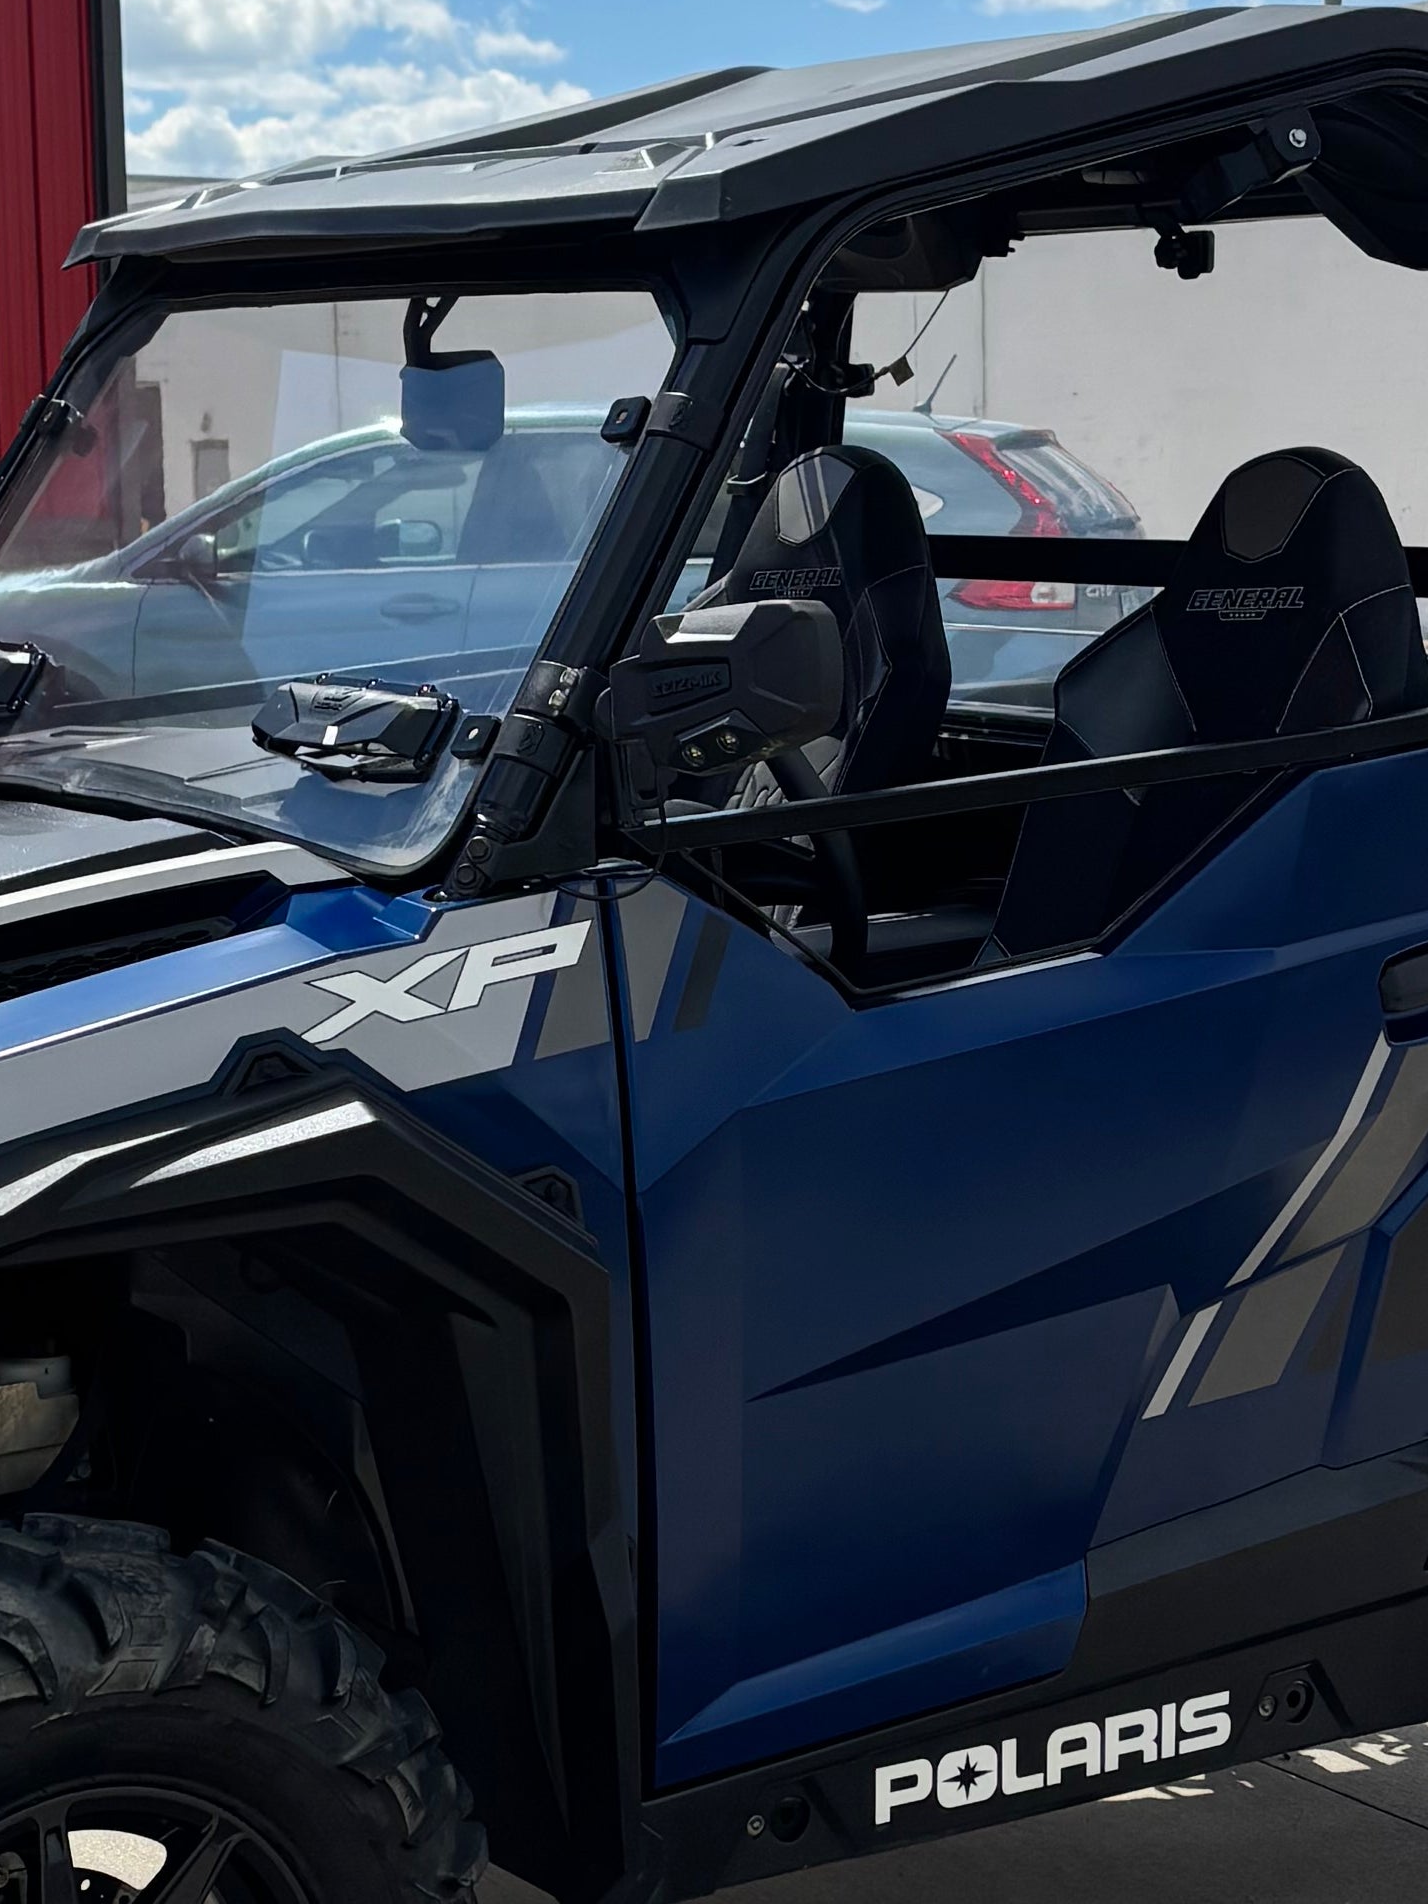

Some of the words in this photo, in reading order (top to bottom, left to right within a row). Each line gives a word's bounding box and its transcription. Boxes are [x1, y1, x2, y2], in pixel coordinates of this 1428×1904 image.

[749, 566, 841, 591] GENERAL
[1186, 586, 1304, 611] GENERAL
[300, 919, 592, 1045] XP
[874, 1690, 1232, 1826] POLARIS
